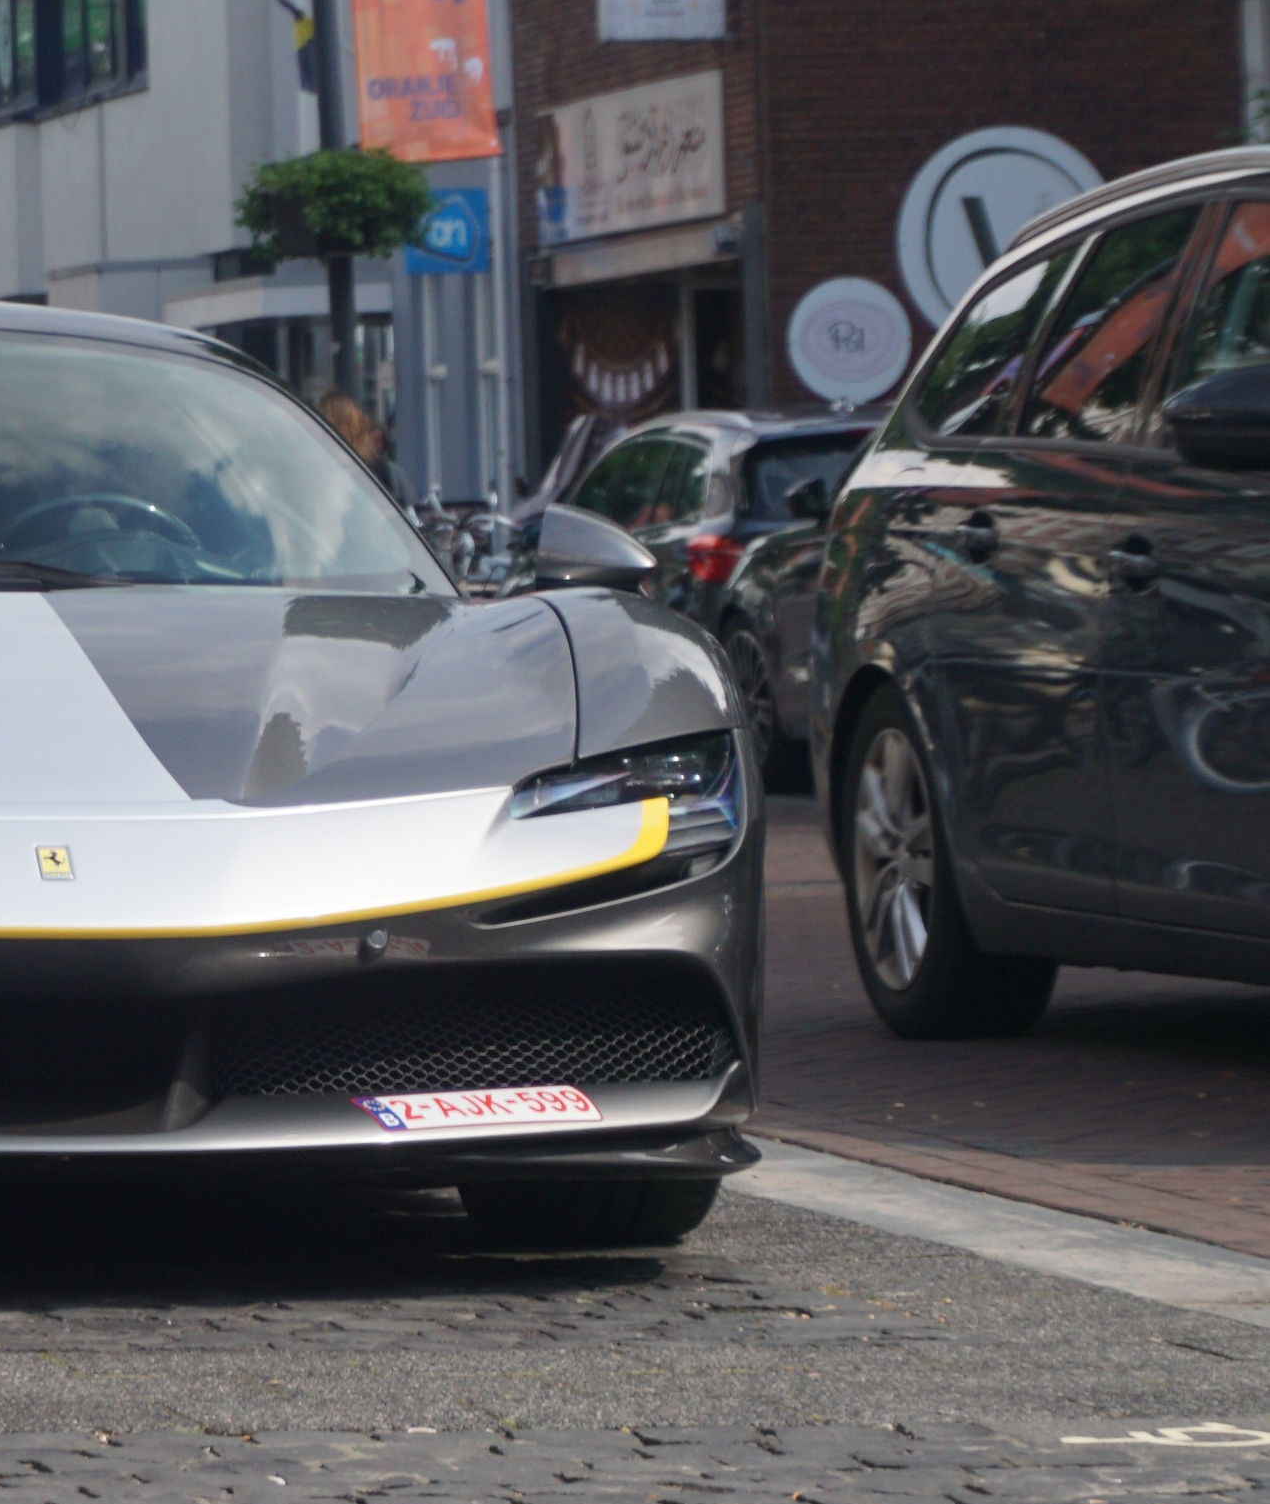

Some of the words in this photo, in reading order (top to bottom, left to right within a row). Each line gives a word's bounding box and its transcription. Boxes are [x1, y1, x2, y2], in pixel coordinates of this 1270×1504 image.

[369, 75, 459, 100] ORANJE
[410, 100, 462, 122] ZUID
[389, 1089, 590, 1120] 2-AJK-599
[379, 1112, 401, 1127] B
